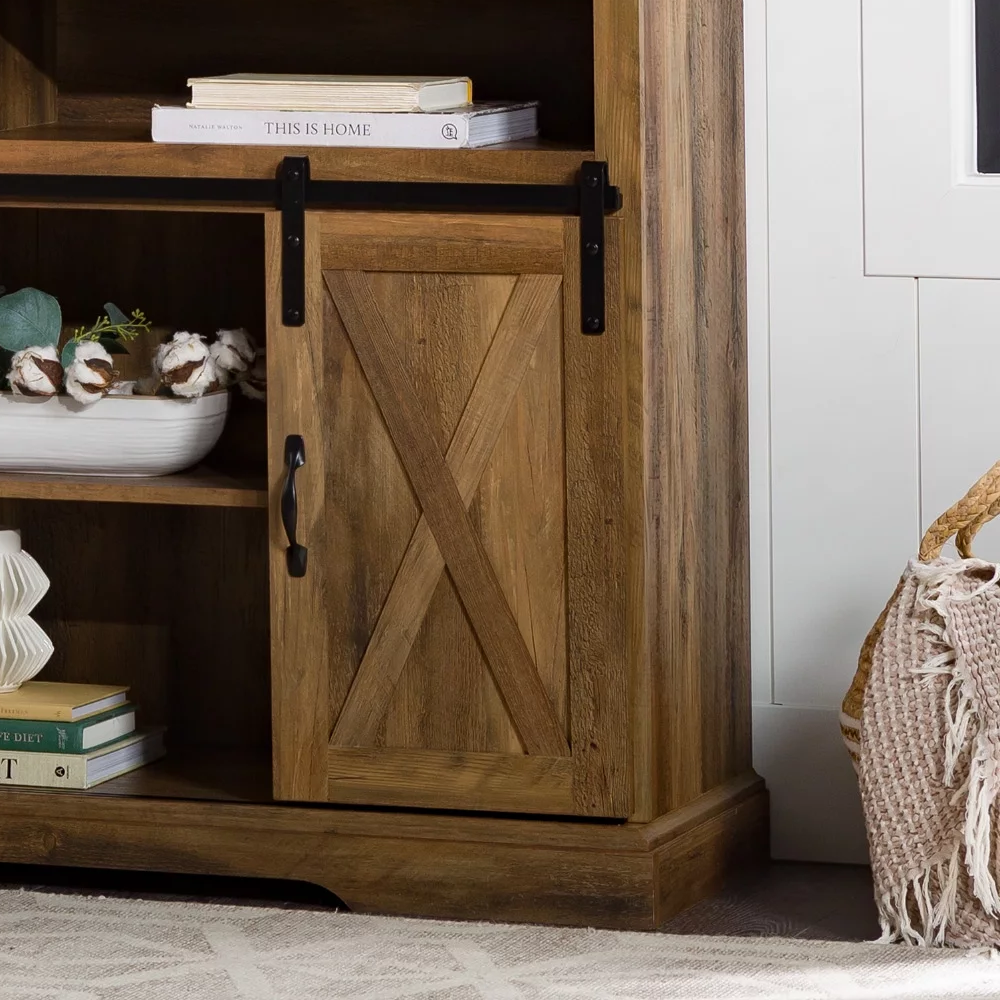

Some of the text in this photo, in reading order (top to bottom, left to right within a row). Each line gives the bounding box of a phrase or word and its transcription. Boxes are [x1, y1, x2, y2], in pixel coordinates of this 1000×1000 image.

[264, 121, 371, 136] THIS IS HOME
[14, 732, 44, 743] DIET
